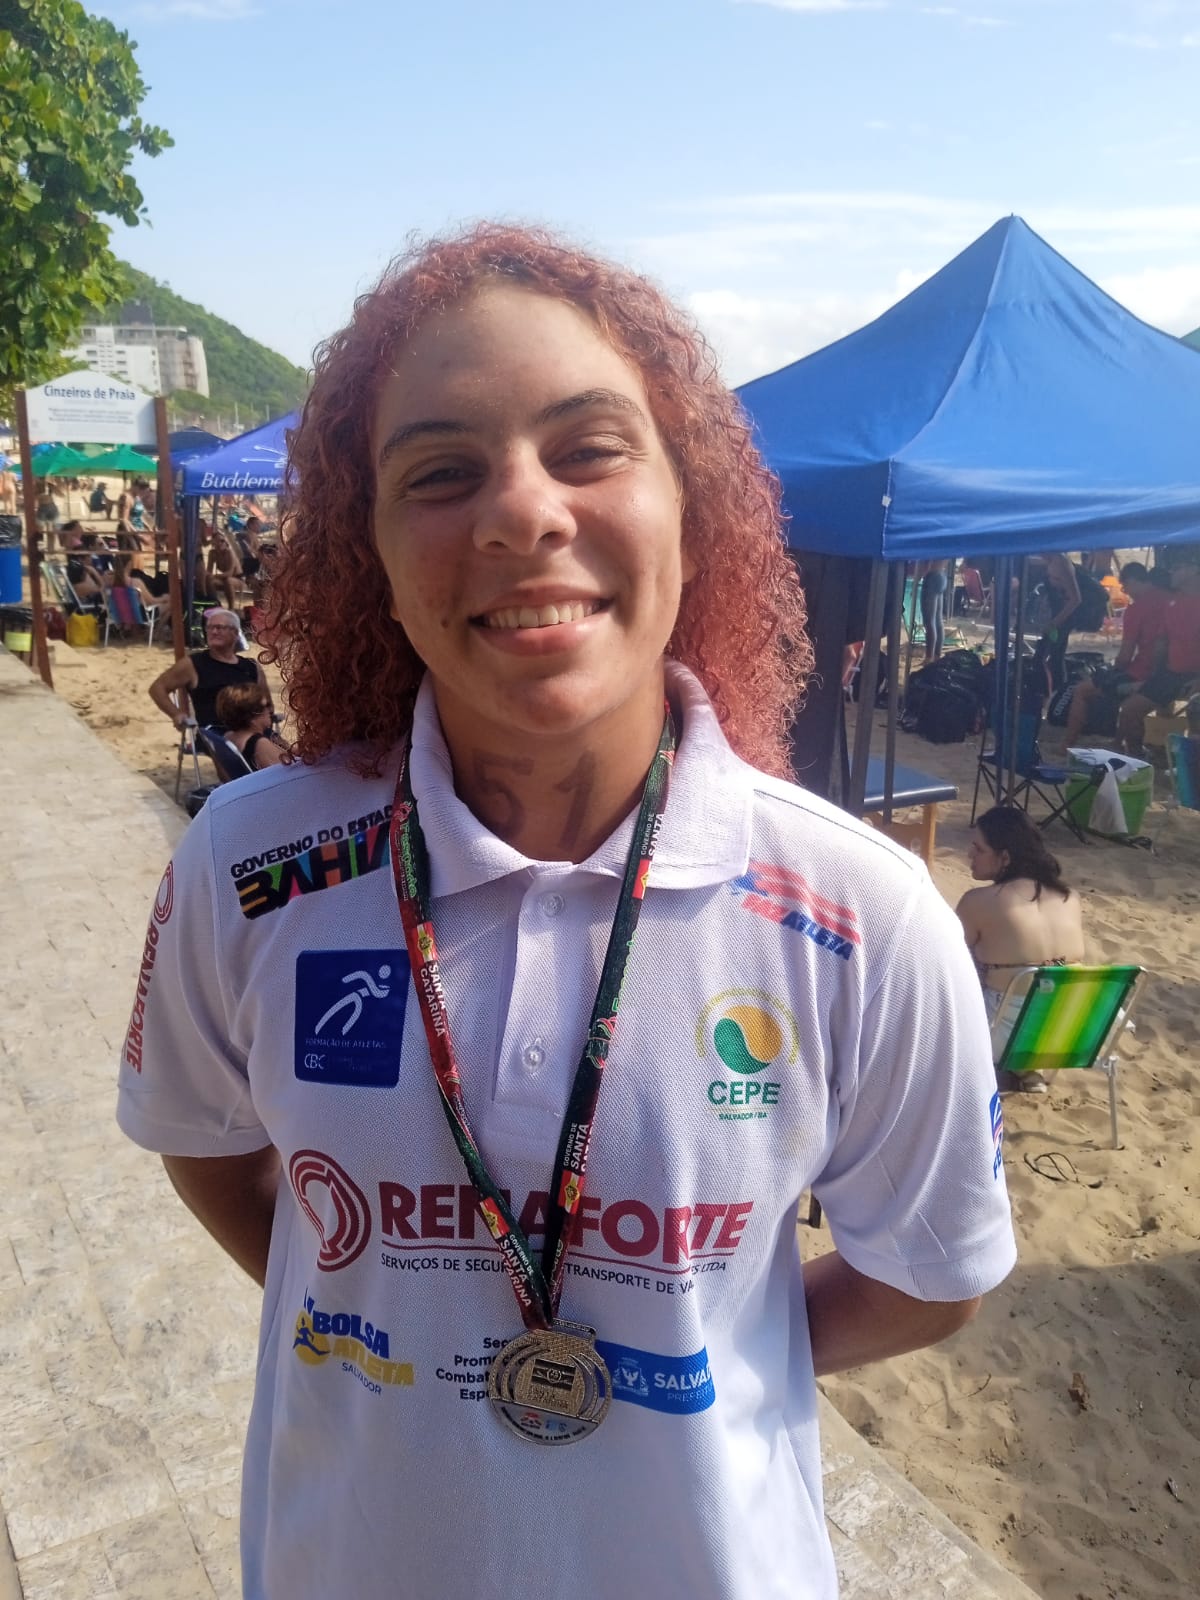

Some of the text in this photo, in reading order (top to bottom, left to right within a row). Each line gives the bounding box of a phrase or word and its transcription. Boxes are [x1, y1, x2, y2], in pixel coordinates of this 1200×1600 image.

[44, 385, 136, 401] Cinzeiros de Praia
[230, 805, 393, 878] GOVERNO DO ESTAD
[420, 968, 446, 1037] CATARINA
[428, 963, 446, 1010] SANTA
[707, 1081, 781, 1105] CEPE
[563, 1122, 578, 1167] GOVERNO DE
[570, 1123, 589, 1170] SANTA
[381, 1252, 439, 1273] SERVIÇOS
[443, 1259, 463, 1271] DE
[566, 1262, 650, 1290] TRANSPORTE
[656, 1280, 674, 1294] DE
[500, 1239, 528, 1282] SANTA
[509, 1233, 534, 1275] GOVERNO DE
[312, 1309, 389, 1359] BOLSA
[341, 1361, 382, 1396] SALVADOR
